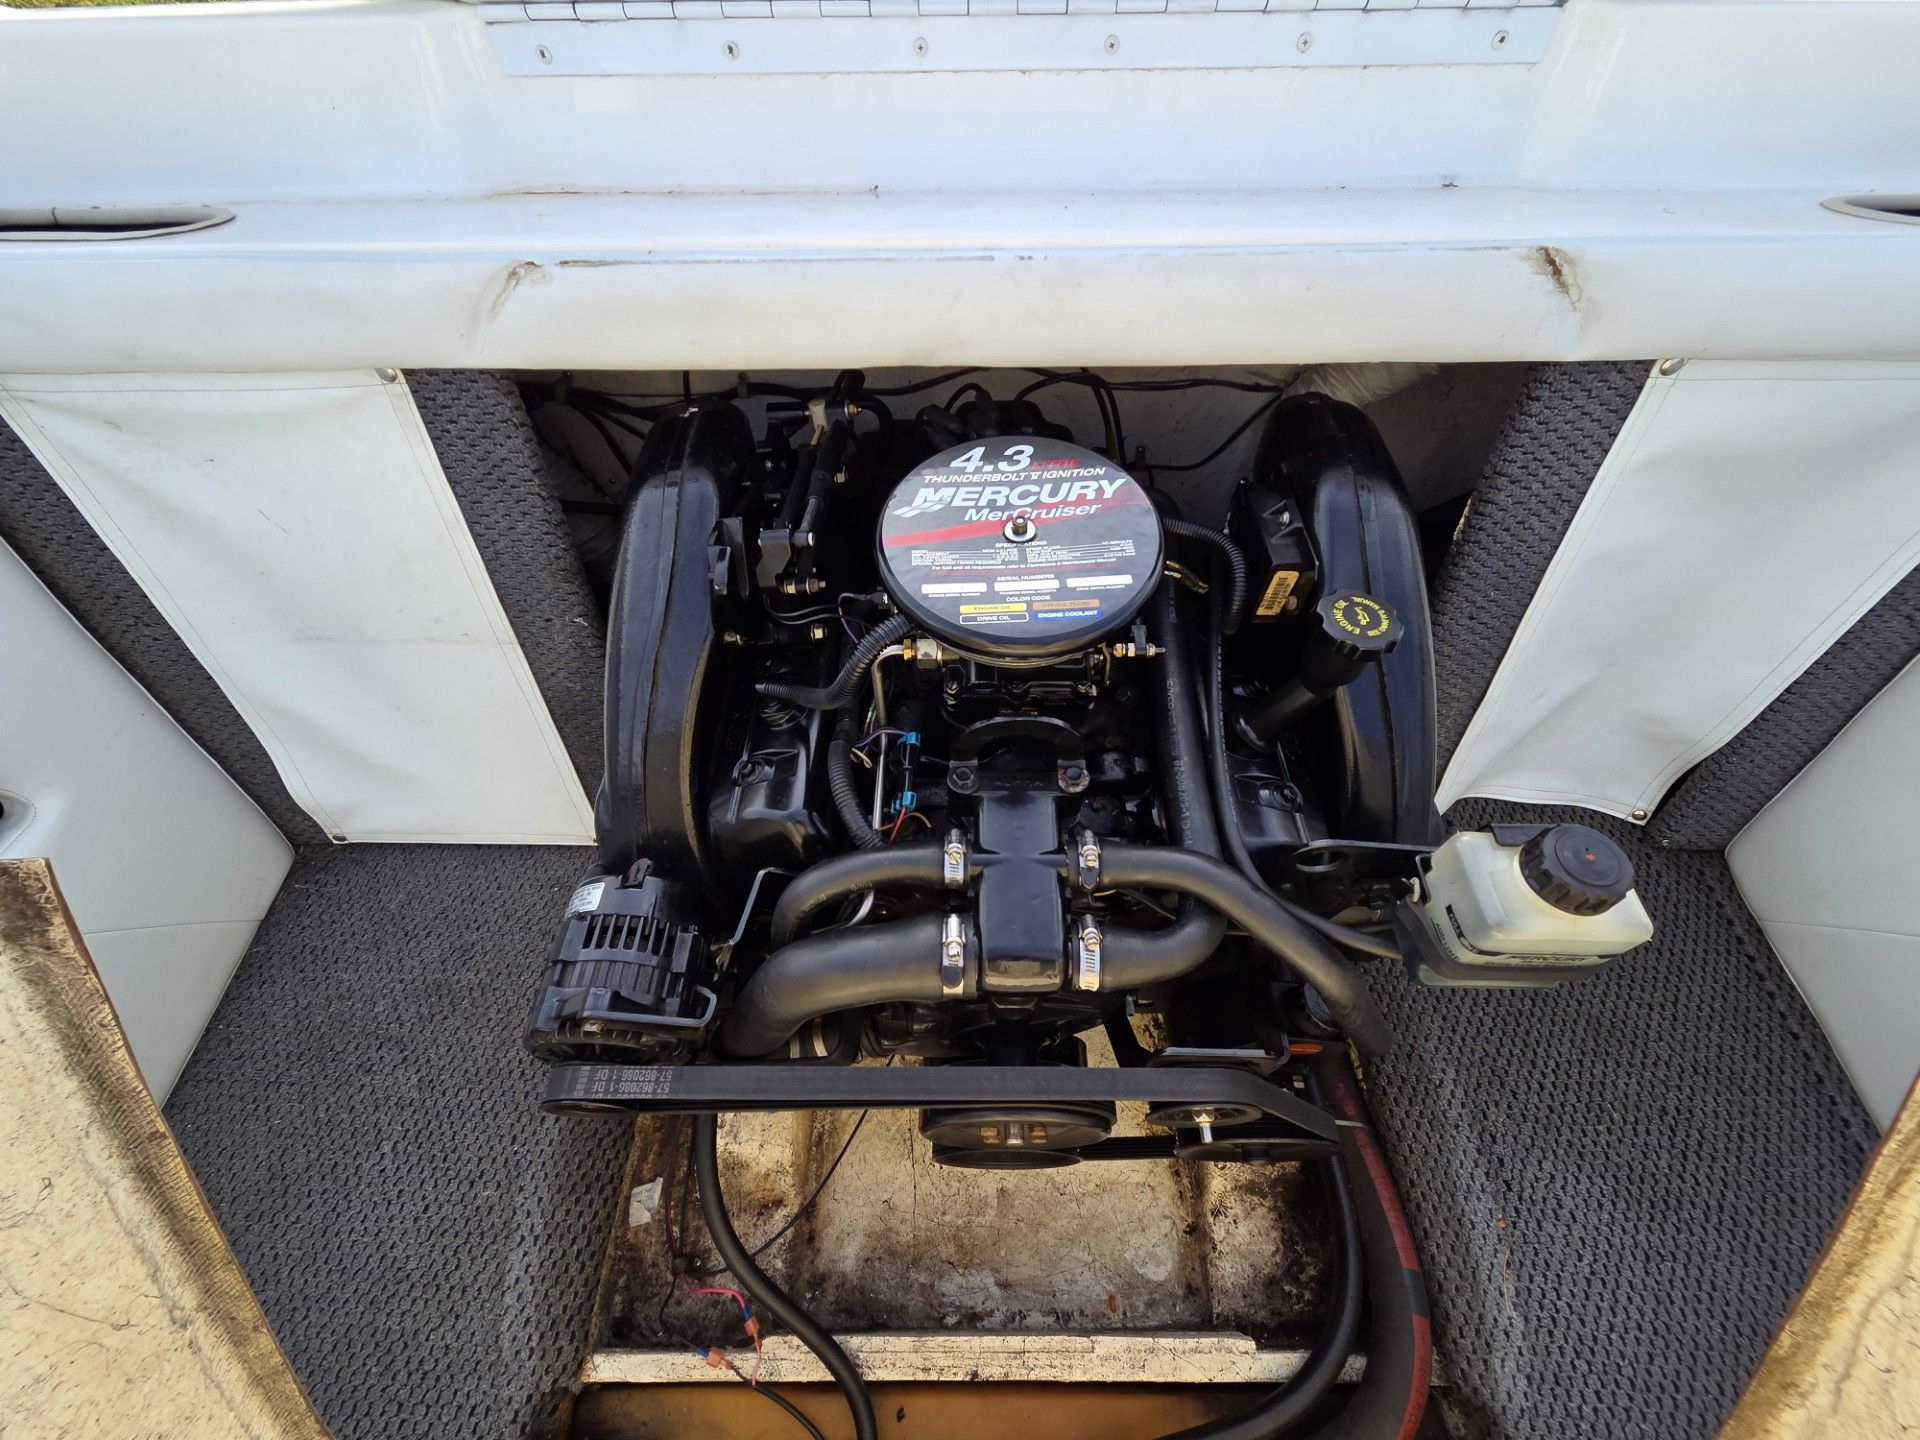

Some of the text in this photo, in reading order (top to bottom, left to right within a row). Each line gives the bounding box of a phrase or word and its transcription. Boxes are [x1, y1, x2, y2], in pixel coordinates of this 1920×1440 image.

[950, 445, 1034, 472] 4.3
[924, 472, 1027, 483] THUNDERBOLT
[1042, 467, 1105, 479] IGNITION
[912, 478, 1127, 507] MERCURY
[964, 503, 1102, 521] MerCruiser
[1333, 608, 1360, 635] ENGINE
